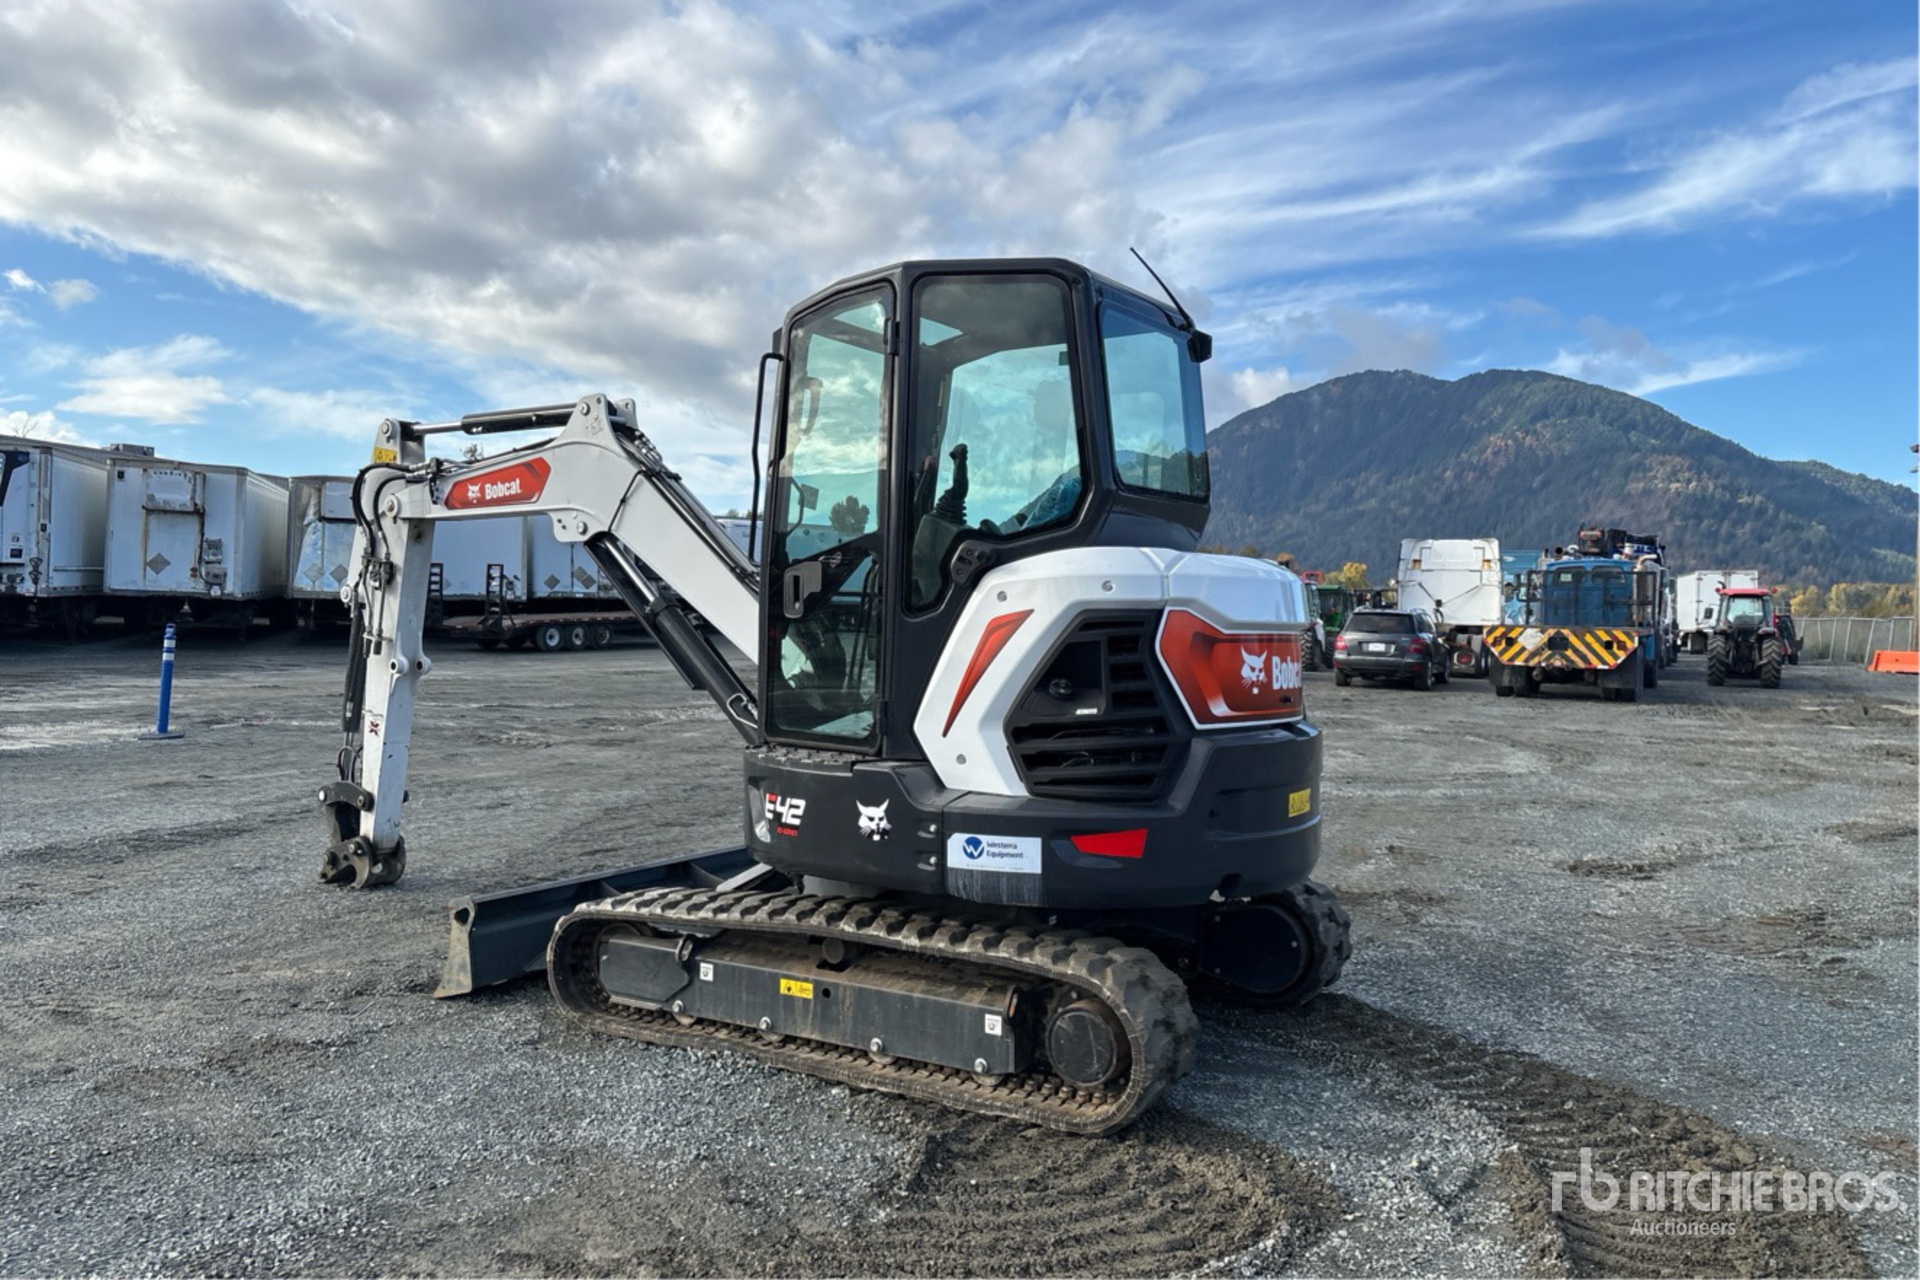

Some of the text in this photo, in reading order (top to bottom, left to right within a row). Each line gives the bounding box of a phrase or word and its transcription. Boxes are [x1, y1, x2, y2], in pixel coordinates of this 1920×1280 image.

[484, 477, 522, 500] Bobcat
[764, 793, 806, 826] E42
[986, 850, 1024, 859] Equipment
